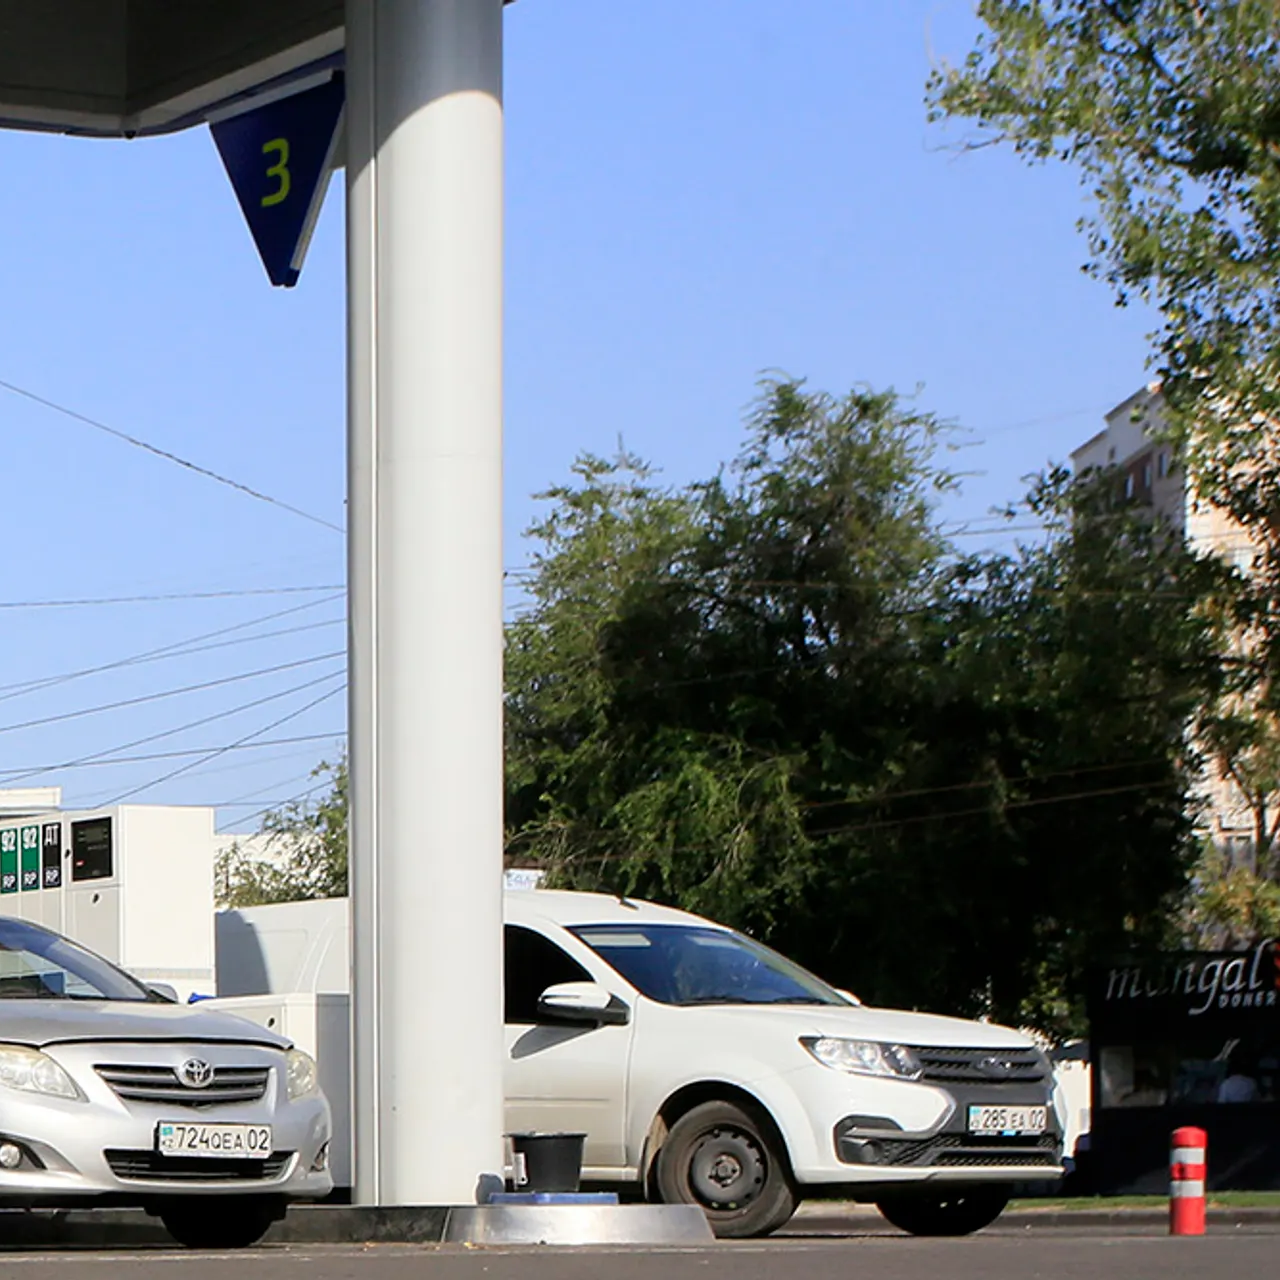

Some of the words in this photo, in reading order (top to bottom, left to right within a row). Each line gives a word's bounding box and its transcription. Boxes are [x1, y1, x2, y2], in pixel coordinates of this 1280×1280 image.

[261, 138, 290, 207] 3
[1, 831, 16, 852] 92
[23, 828, 37, 850] 92
[1218, 989, 1277, 1008] DONER
[1029, 1109, 1045, 1128] 02
[247, 1129, 269, 1150] 02
